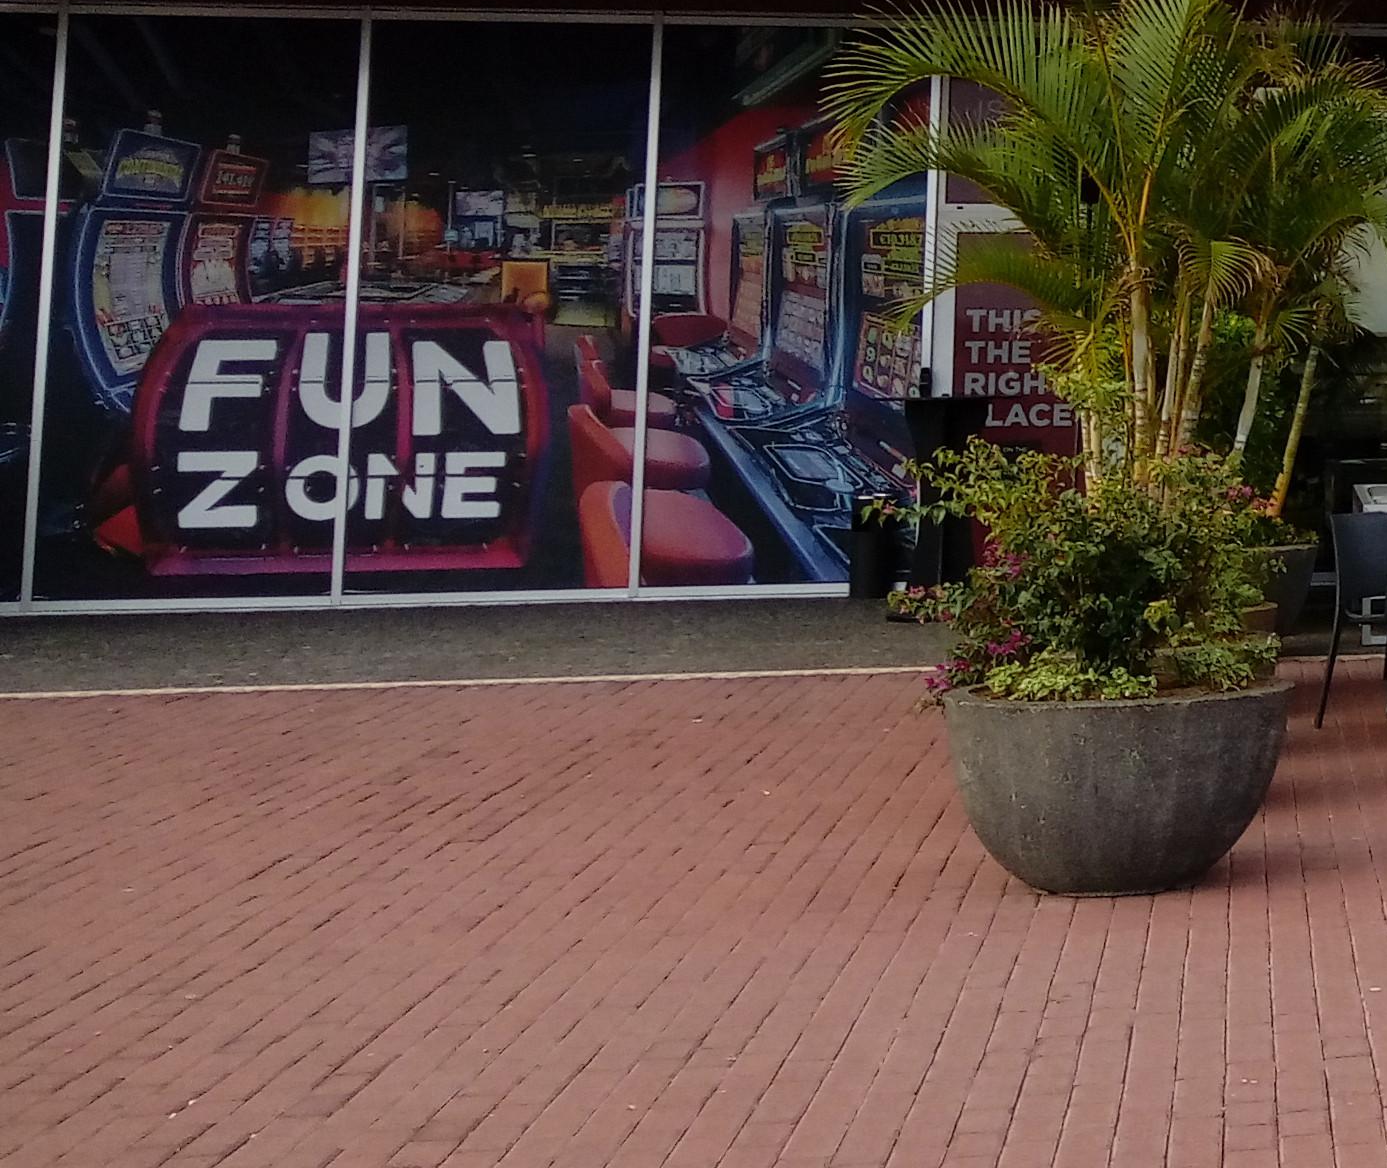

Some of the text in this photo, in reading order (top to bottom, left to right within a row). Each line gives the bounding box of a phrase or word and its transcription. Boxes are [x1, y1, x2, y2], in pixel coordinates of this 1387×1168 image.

[965, 340, 1031, 364] THE
[178, 331, 521, 437] FUN
[964, 372, 1047, 396] RIGH
[985, 403, 1073, 427] LACE
[177, 450, 507, 529] ZONE
